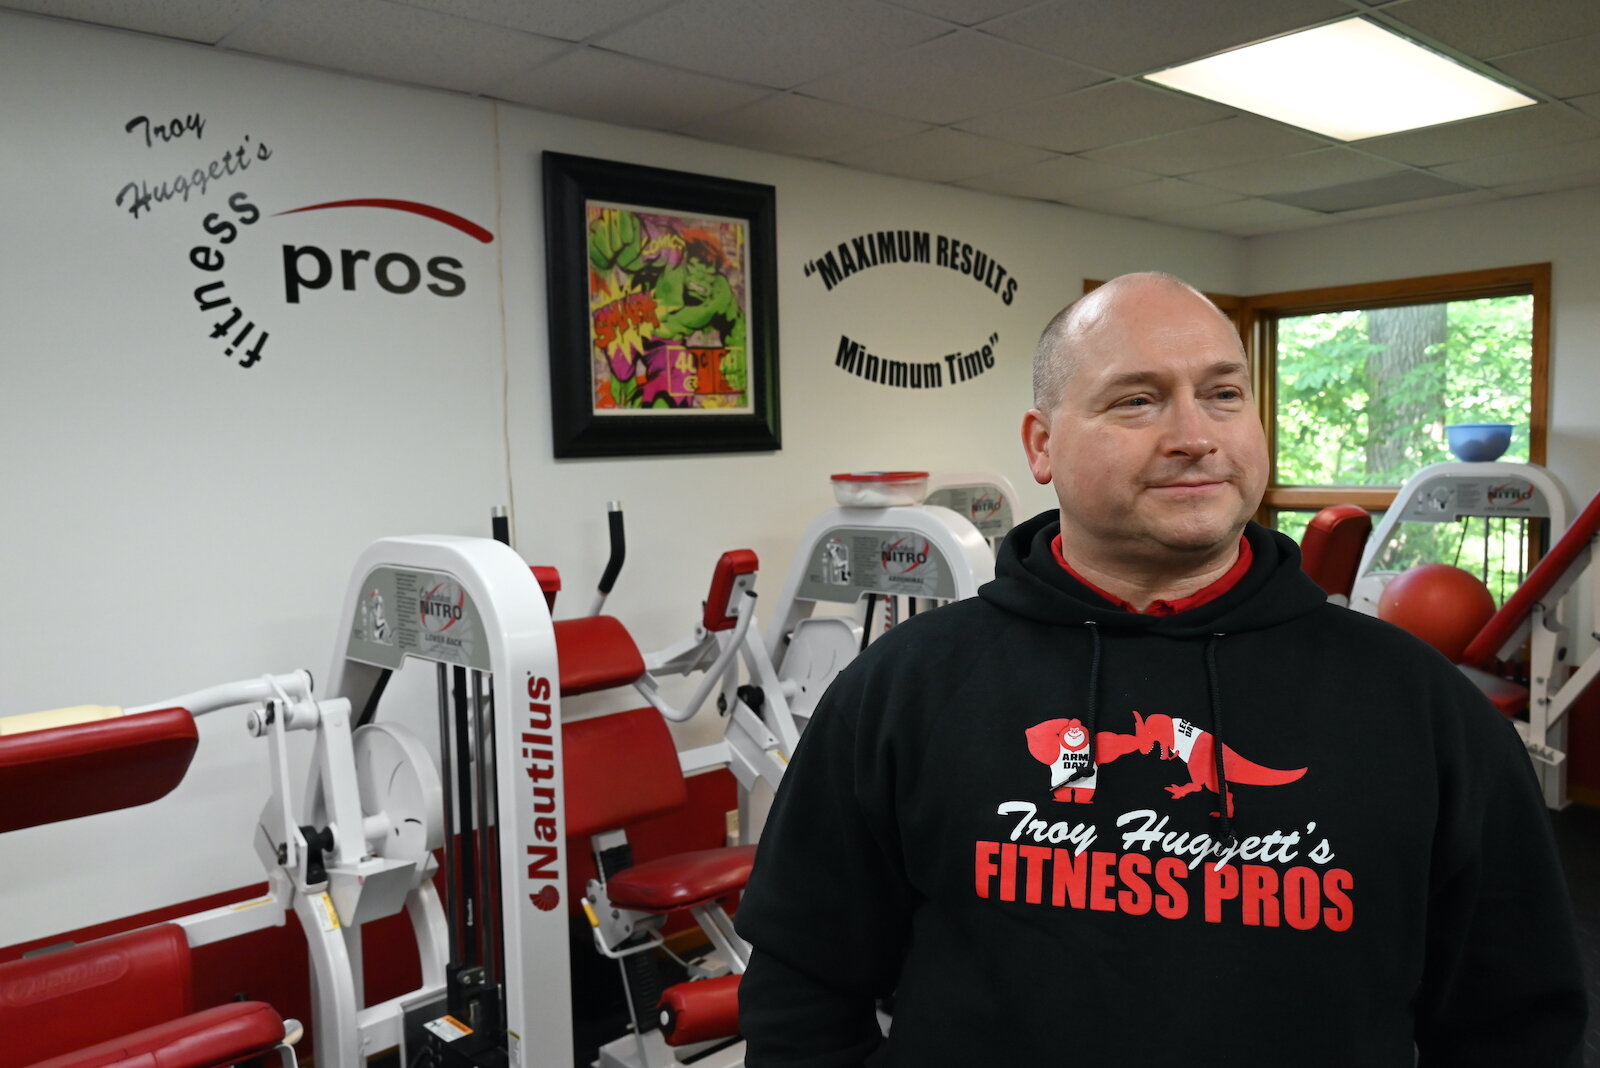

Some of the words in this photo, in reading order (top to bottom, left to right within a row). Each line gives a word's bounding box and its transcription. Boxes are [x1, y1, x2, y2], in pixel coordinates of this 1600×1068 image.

[125, 113, 206, 147] Troy
[115, 135, 272, 219] Huggett's
[189, 192, 269, 368] fitness
[282, 244, 466, 304] pros
[936, 235, 1018, 306] RESULTS
[835, 334, 942, 388] Minimum
[881, 551, 927, 564] NITRO
[420, 600, 463, 620] NITRO
[522, 674, 559, 880] Nautilus
[1062, 753, 1088, 761] ARM
[997, 801, 1097, 857] Troy
[975, 840, 1189, 920] FITNESS
[1204, 861, 1354, 932] PROS
